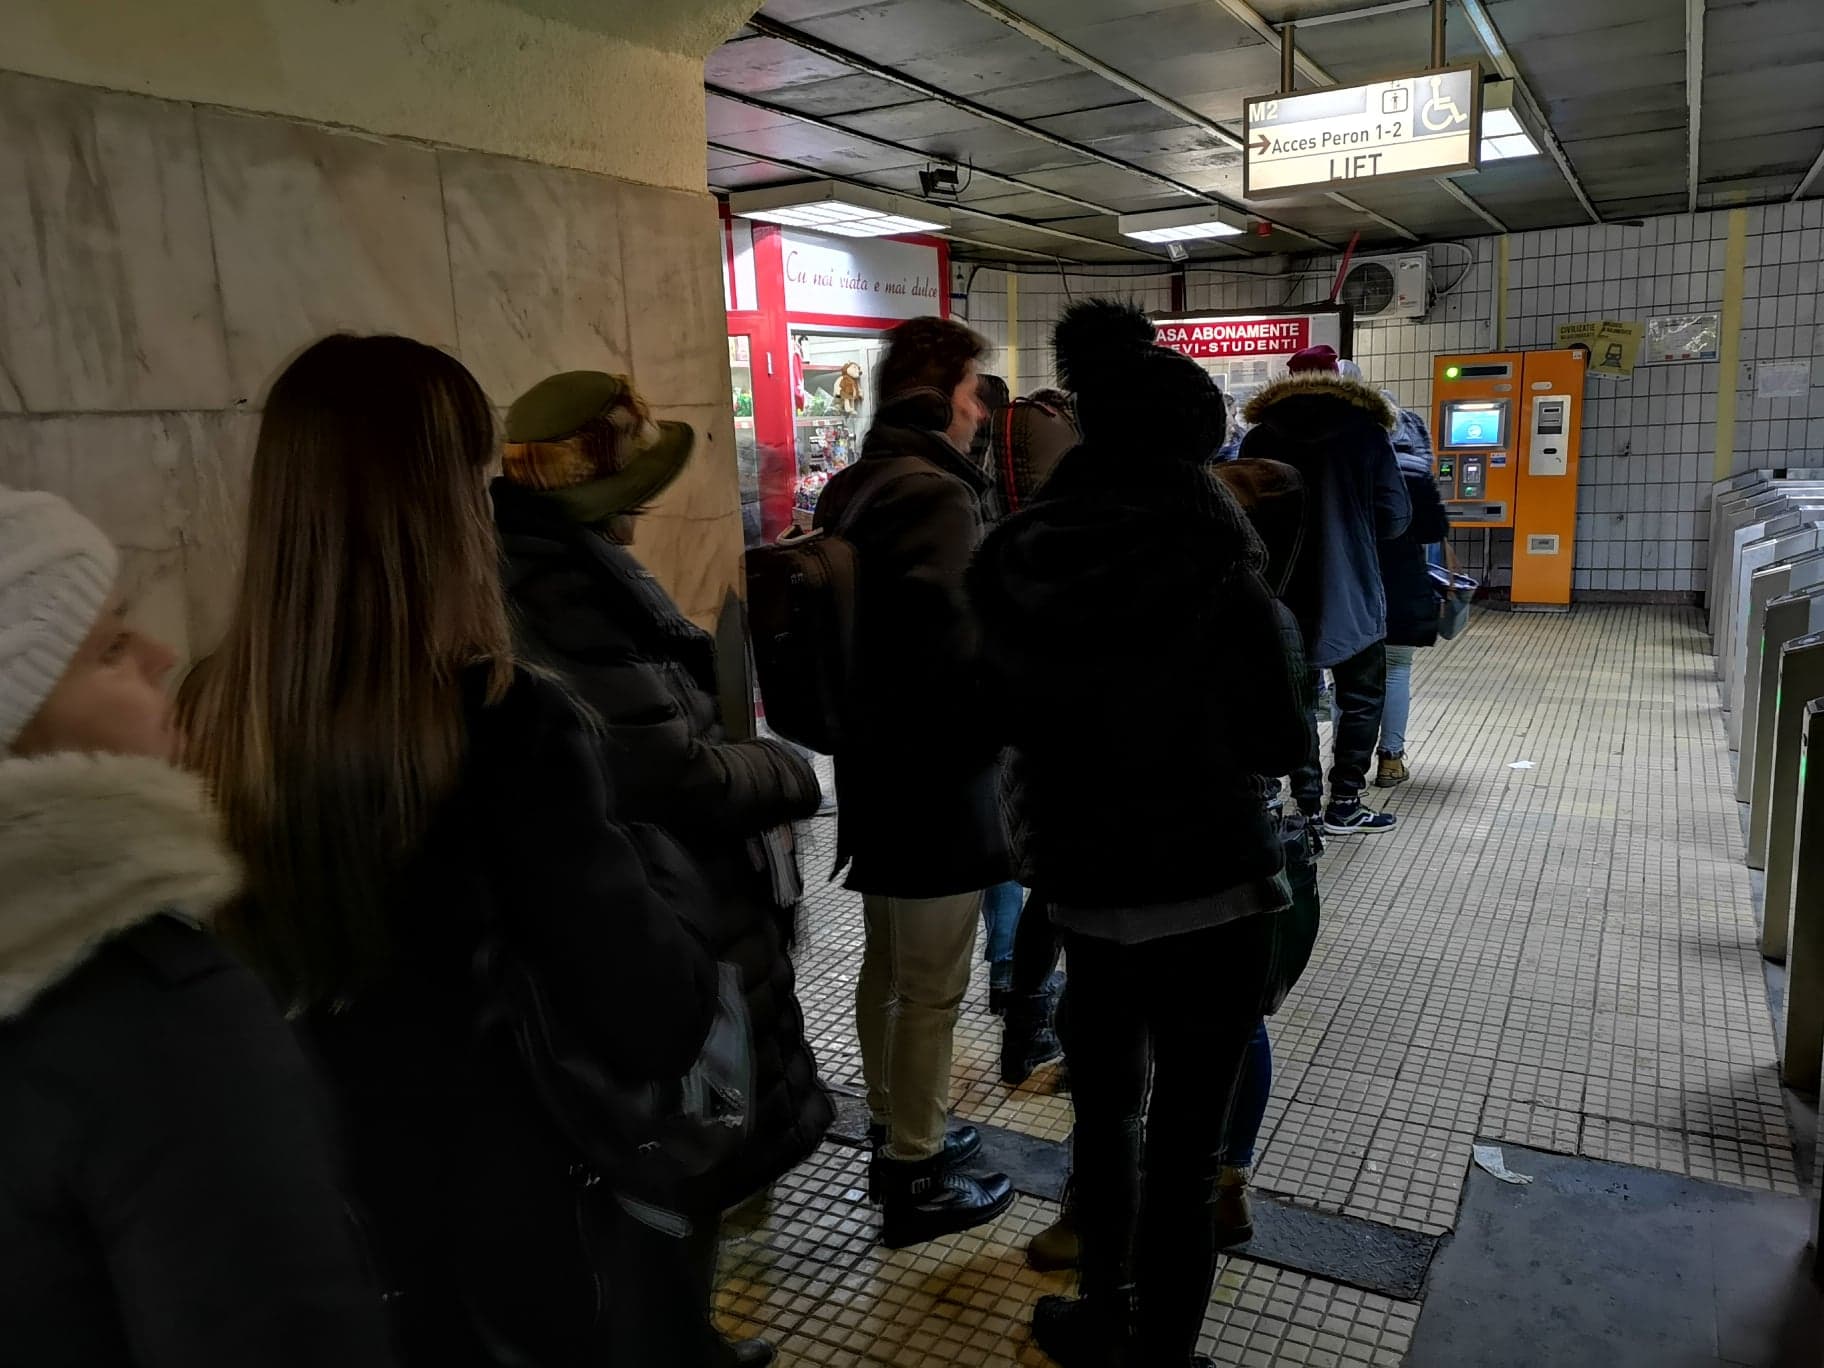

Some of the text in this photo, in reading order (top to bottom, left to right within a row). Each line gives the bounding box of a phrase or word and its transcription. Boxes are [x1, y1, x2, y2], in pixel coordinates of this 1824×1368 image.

[1249, 102, 1279, 123] M2
[1272, 122, 1403, 155] Acces Peron 1-2
[1329, 153, 1383, 181] LIFT
[786, 250, 938, 298] Cu noi viata e mai dulce
[1156, 323, 1300, 342] ASA ABONAMENTE
[1171, 338, 1297, 354] EVI-STUDENTI
